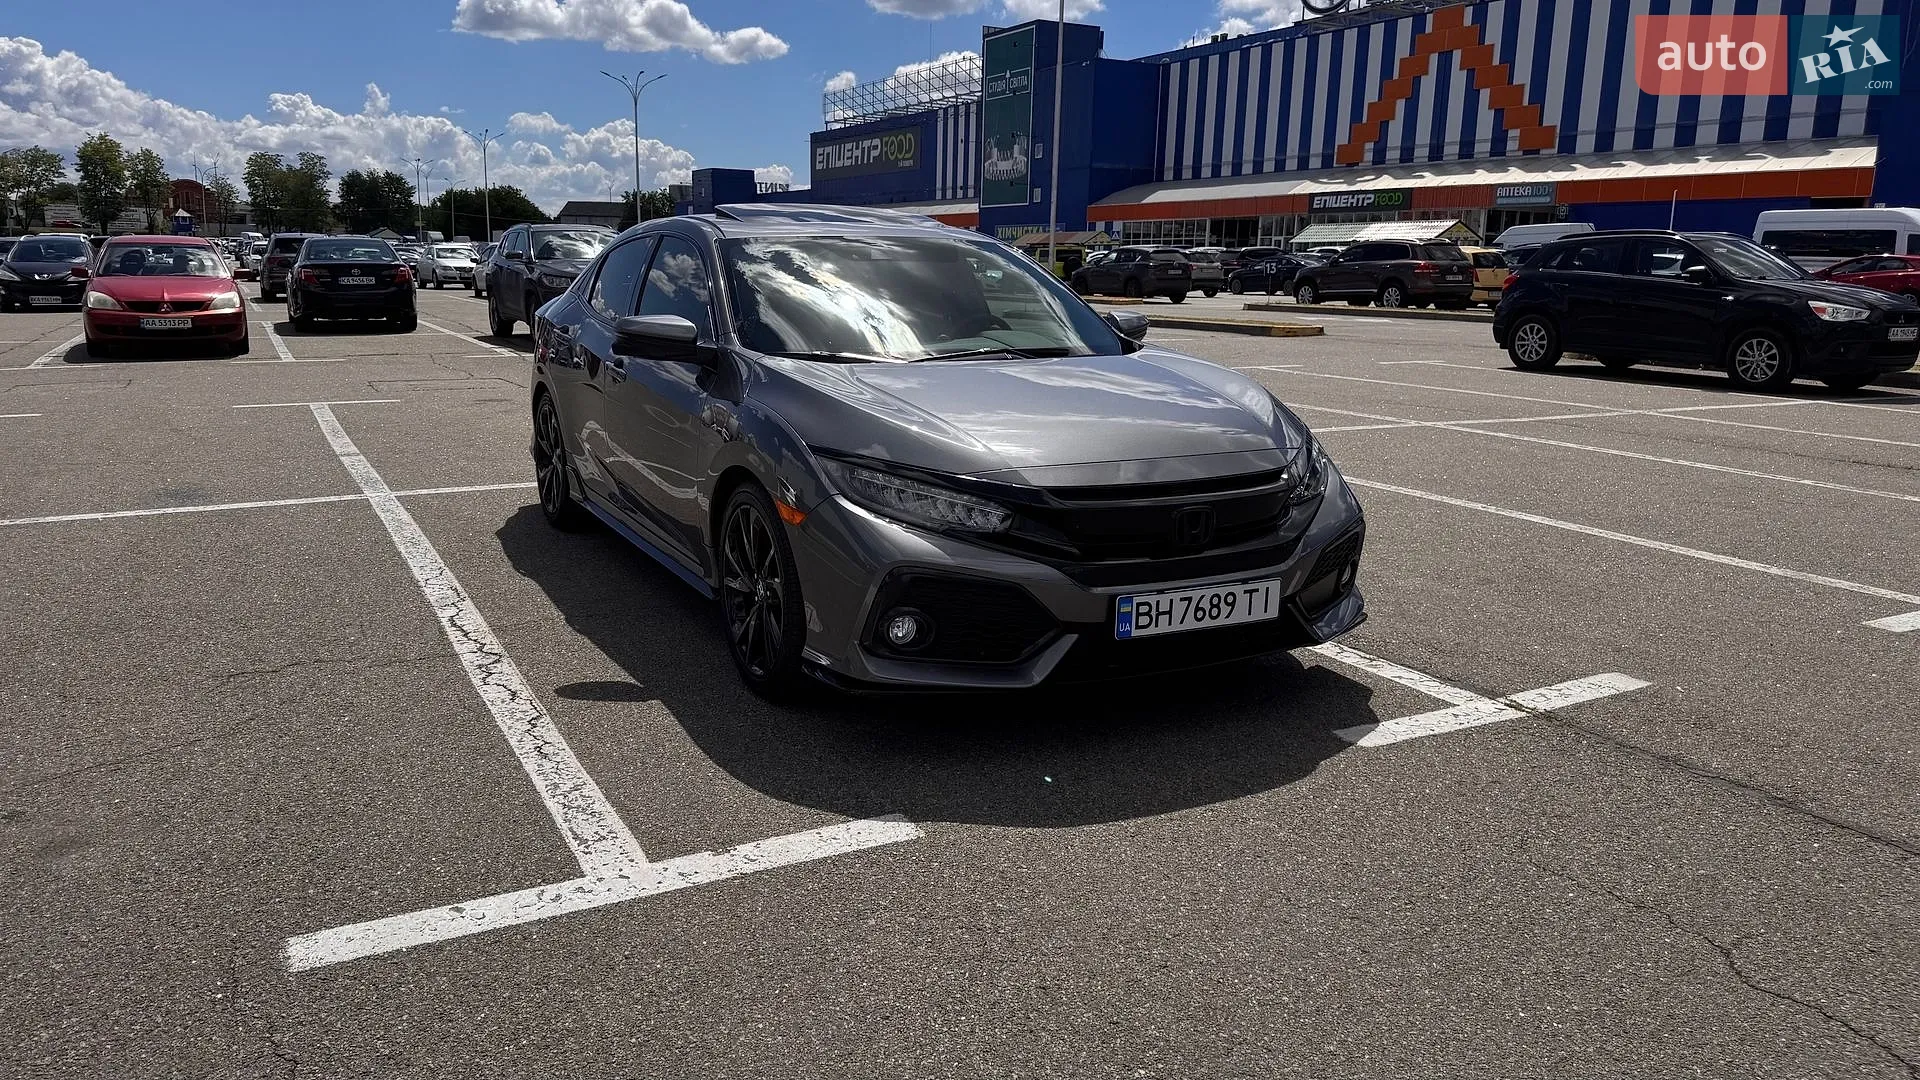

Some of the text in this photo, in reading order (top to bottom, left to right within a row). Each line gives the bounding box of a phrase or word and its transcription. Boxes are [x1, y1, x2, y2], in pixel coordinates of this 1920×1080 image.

[815, 133, 915, 170] ЕПІЦЕНТР FOOD
[1496, 185, 1532, 197] АПТЕКА
[1312, 191, 1403, 209] ЕПІЦЕНТР FOOD
[1265, 262, 1277, 274] 13
[145, 319, 157, 327] AA
[1134, 586, 1270, 631] BH 7689 TI
[1119, 622, 1131, 632] UA
